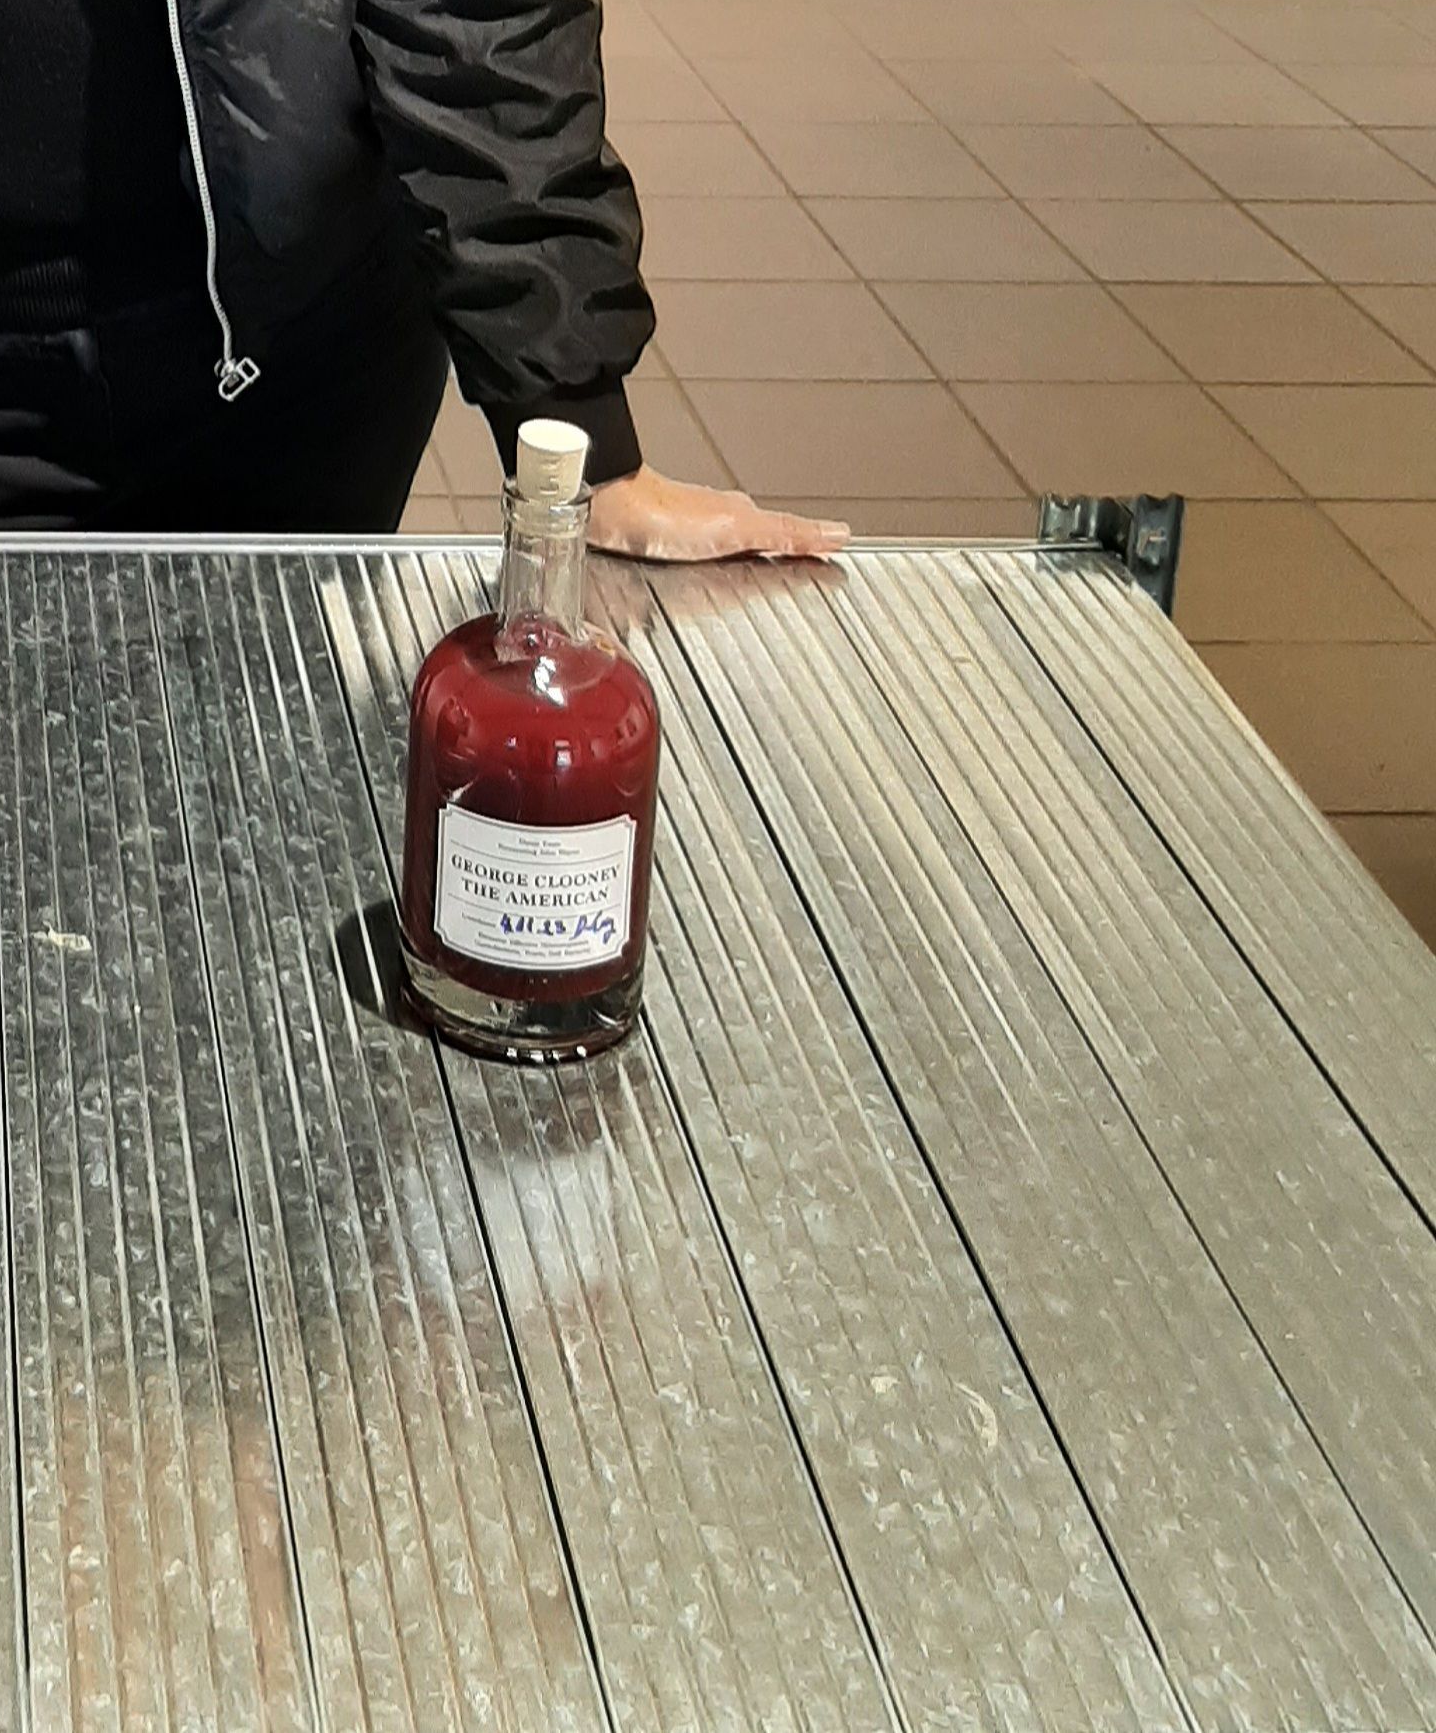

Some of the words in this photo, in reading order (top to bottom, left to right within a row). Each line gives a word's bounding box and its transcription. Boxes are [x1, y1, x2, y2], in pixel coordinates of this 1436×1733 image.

[451, 853, 528, 886] GEORGE
[534, 864, 620, 888] CLOONEY
[462, 877, 500, 901] THE
[505, 886, 609, 906] AMERICAN
